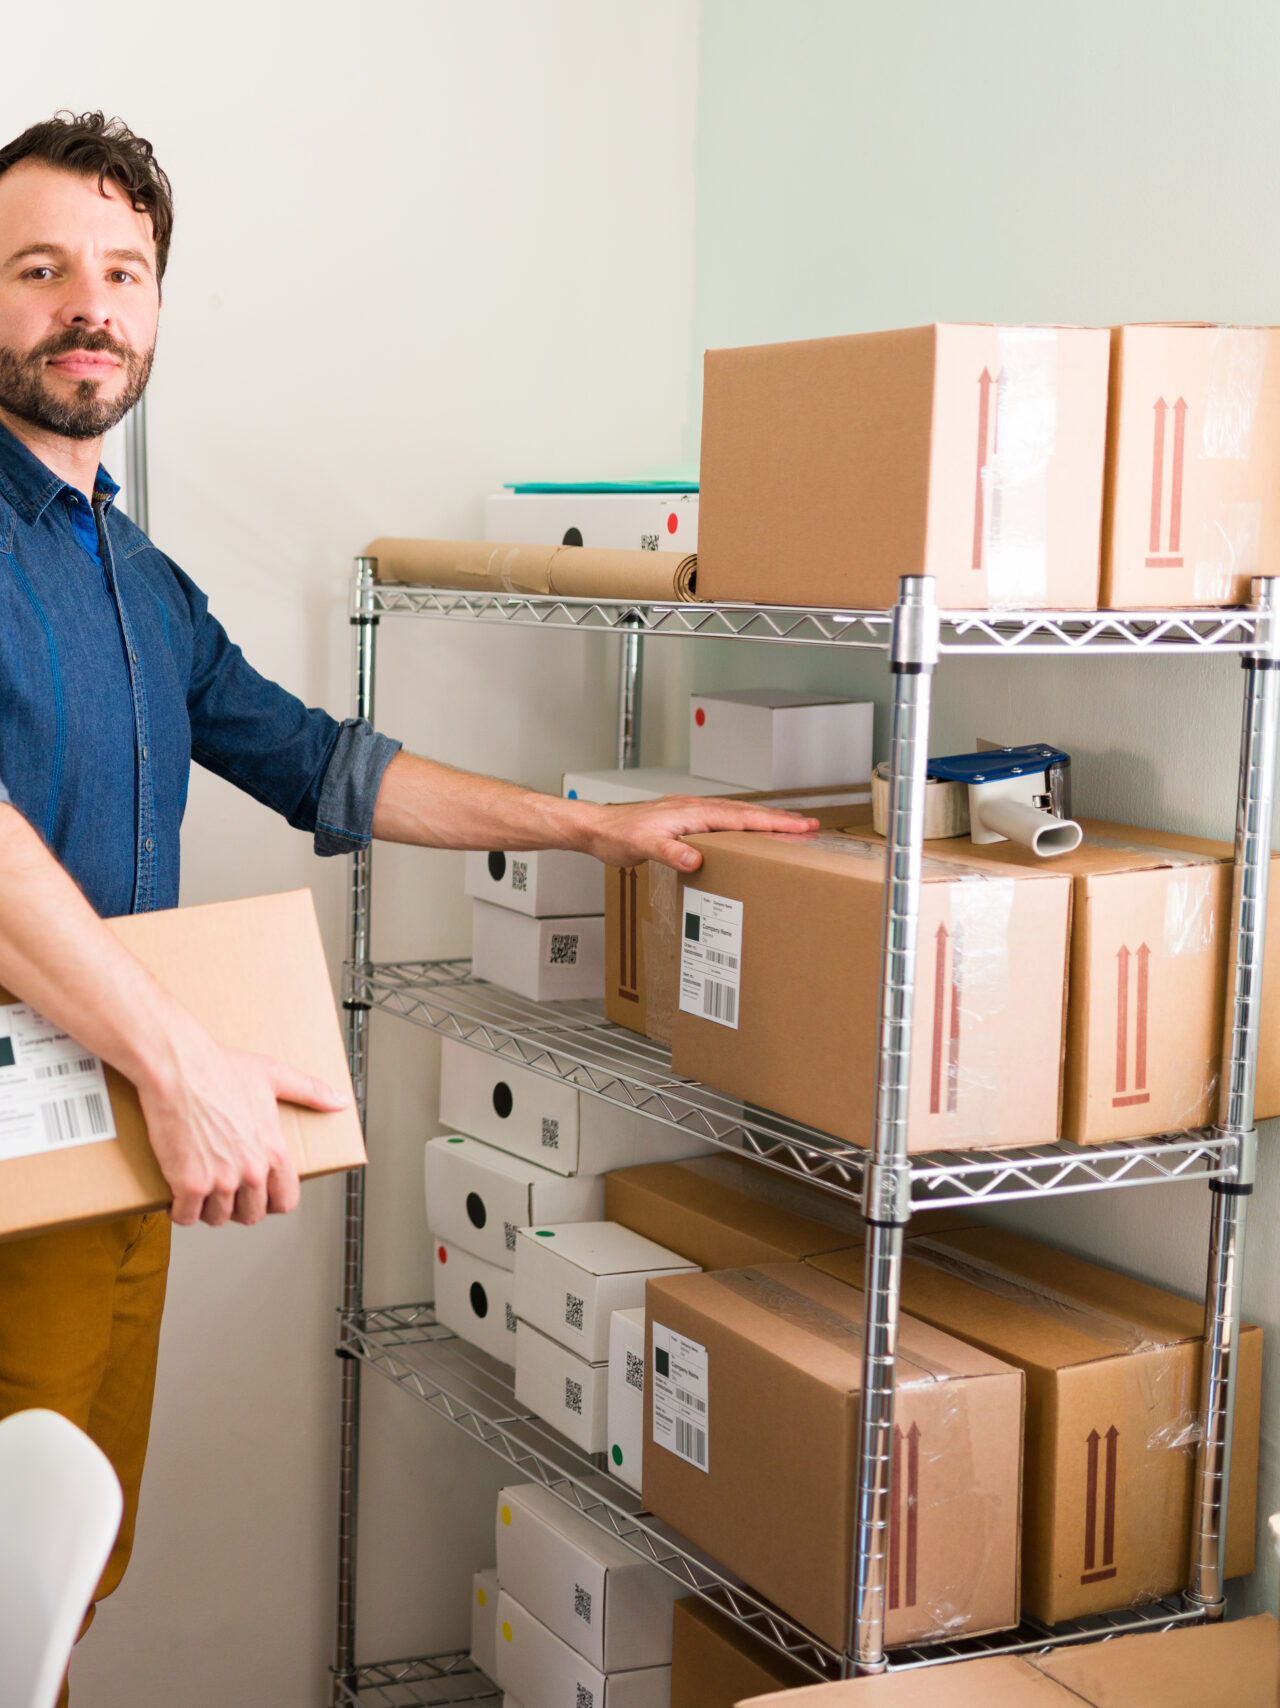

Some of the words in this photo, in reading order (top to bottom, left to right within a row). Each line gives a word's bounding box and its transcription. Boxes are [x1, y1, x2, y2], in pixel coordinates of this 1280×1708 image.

[702, 923, 720, 934] Company
[720, 928, 732, 937] Name
[671, 1361, 688, 1375] Company
[688, 1370, 699, 1380] Name
